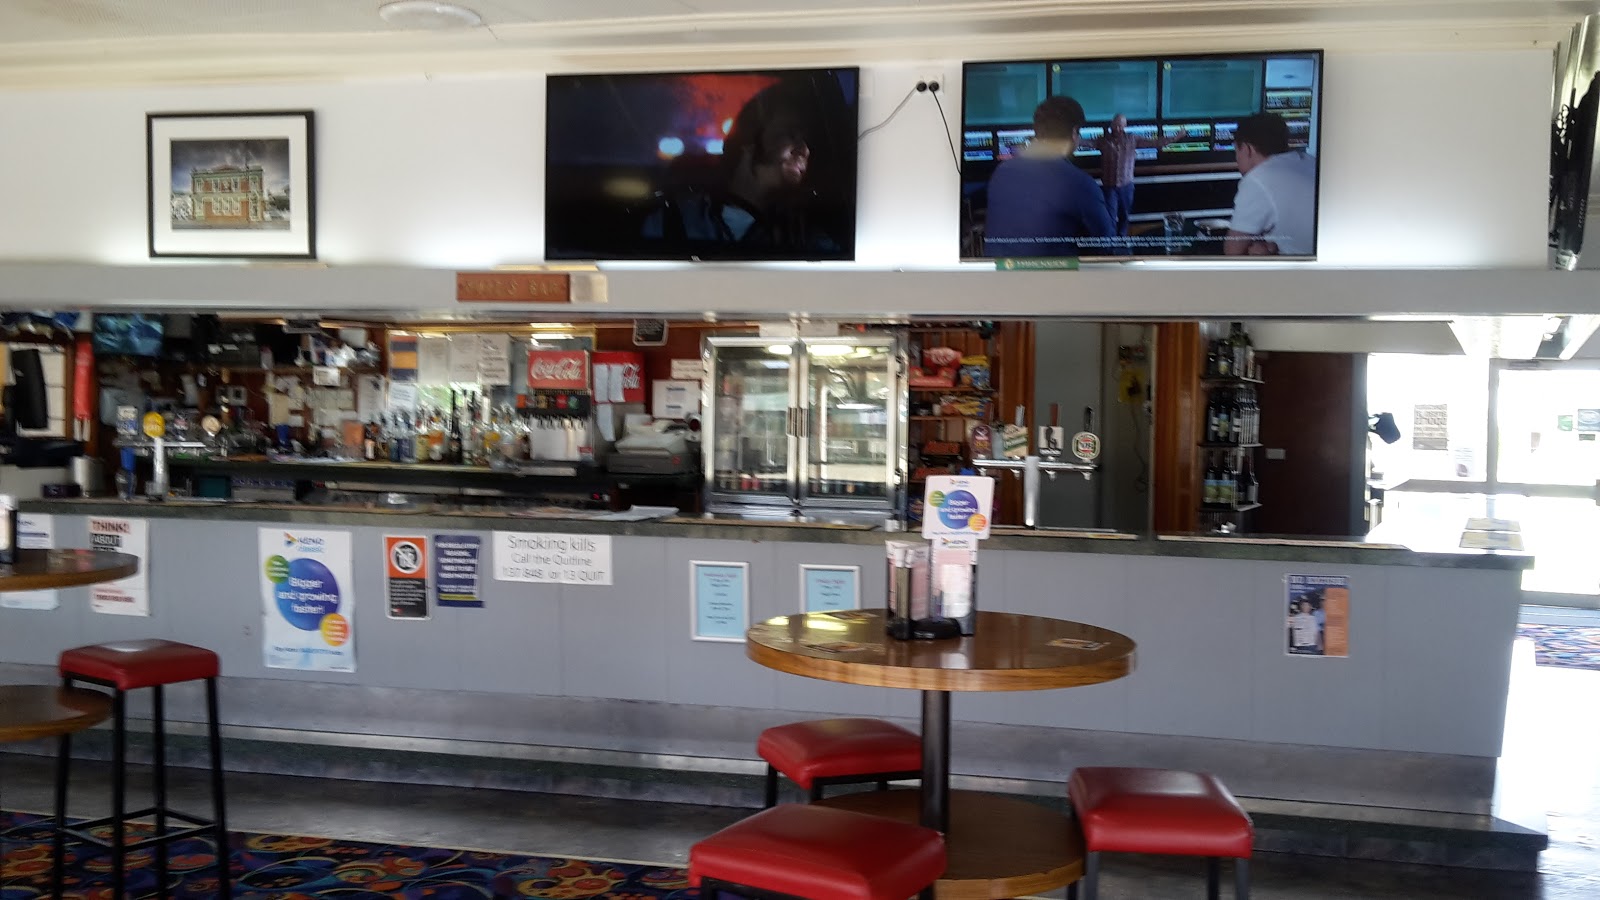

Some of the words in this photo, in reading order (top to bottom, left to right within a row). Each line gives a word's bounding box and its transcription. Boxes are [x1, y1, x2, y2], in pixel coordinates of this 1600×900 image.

[507, 534, 567, 554] Smoking
[569, 537, 596, 553] kills
[511, 552, 529, 564] Call
[533, 555, 551, 565] the
[578, 570, 605, 582] QUIT
[288, 577, 324, 589] Bigger
[277, 590, 297, 600] and
[299, 590, 338, 604] growing
